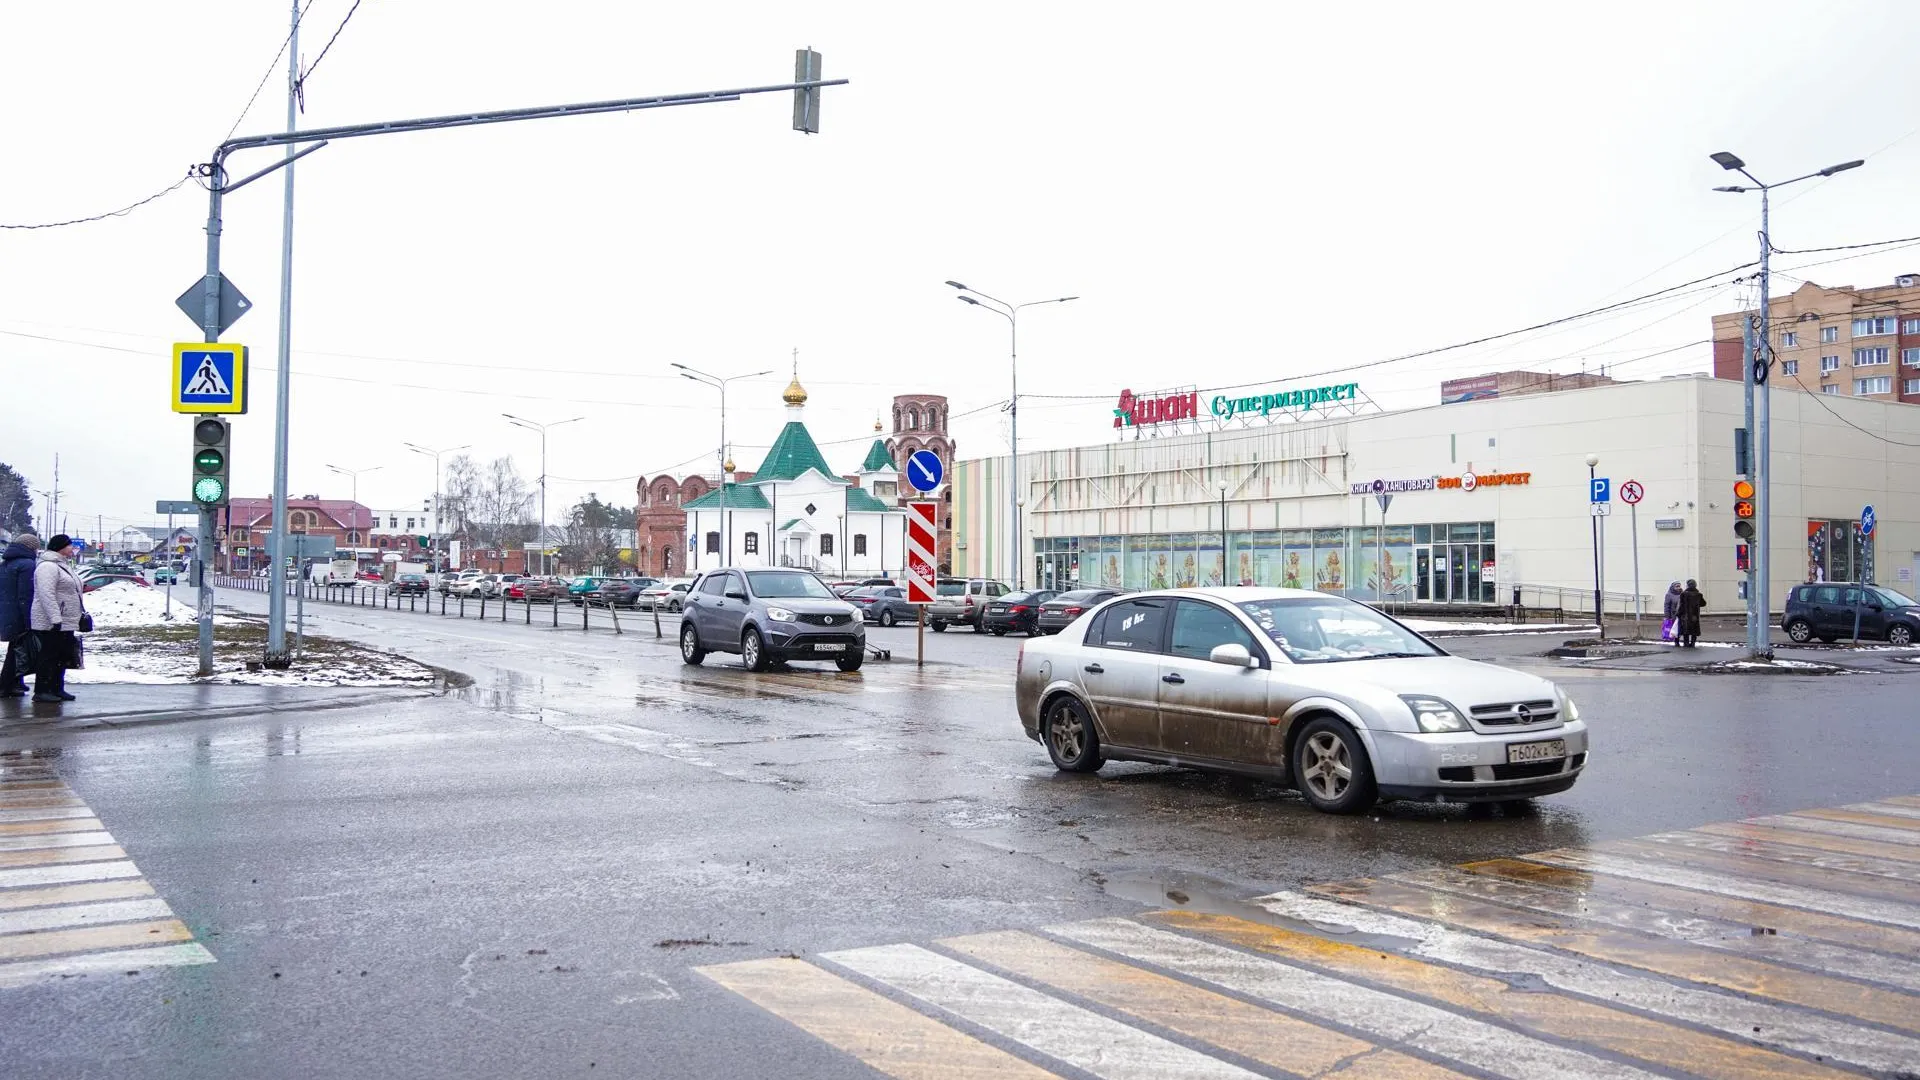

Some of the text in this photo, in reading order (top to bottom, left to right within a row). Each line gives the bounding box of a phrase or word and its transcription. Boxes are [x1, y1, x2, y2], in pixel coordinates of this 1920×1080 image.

[1211, 383, 1358, 420] Супермаркет
[1350, 478, 1434, 495] КНИГИ КАНЦТОВАРЫ
[1436, 472, 1531, 490] ЗОО МАРКЕТ
